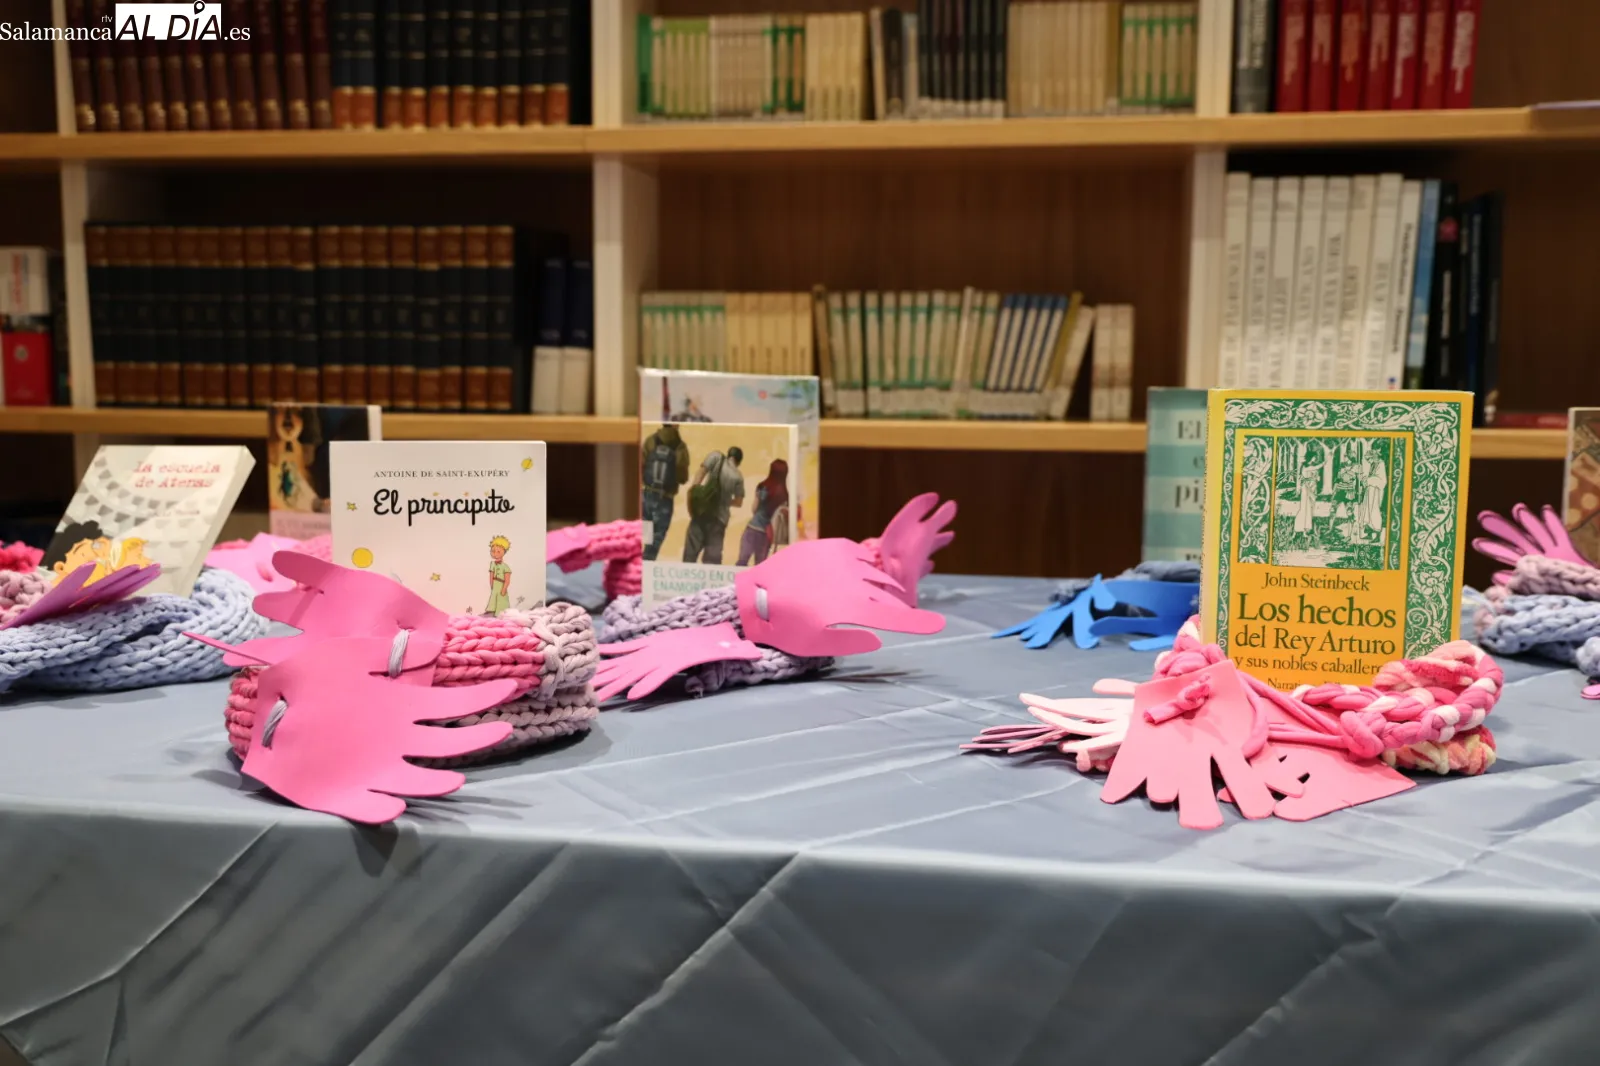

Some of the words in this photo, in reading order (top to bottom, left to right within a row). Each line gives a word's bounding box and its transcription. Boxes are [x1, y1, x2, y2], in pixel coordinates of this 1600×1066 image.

[373, 470, 418, 478] ANTOINE
[436, 469, 510, 478] SAINT-EXUPÉRY
[373, 488, 402, 515] El
[408, 488, 515, 527] principito
[653, 566, 665, 578] EL
[668, 568, 706, 580] CURSO
[1261, 572, 1297, 590] John
[1300, 574, 1370, 592] Steinbeck
[1237, 593, 1290, 622] Los
[1297, 594, 1397, 628] hechos
[1235, 625, 1266, 648] del
[1273, 628, 1316, 657] Rey
[1319, 631, 1396, 655] Arturo
[1234, 656, 1243, 668] y
[1246, 657, 1269, 668] sus
[1272, 655, 1317, 671] nobles
